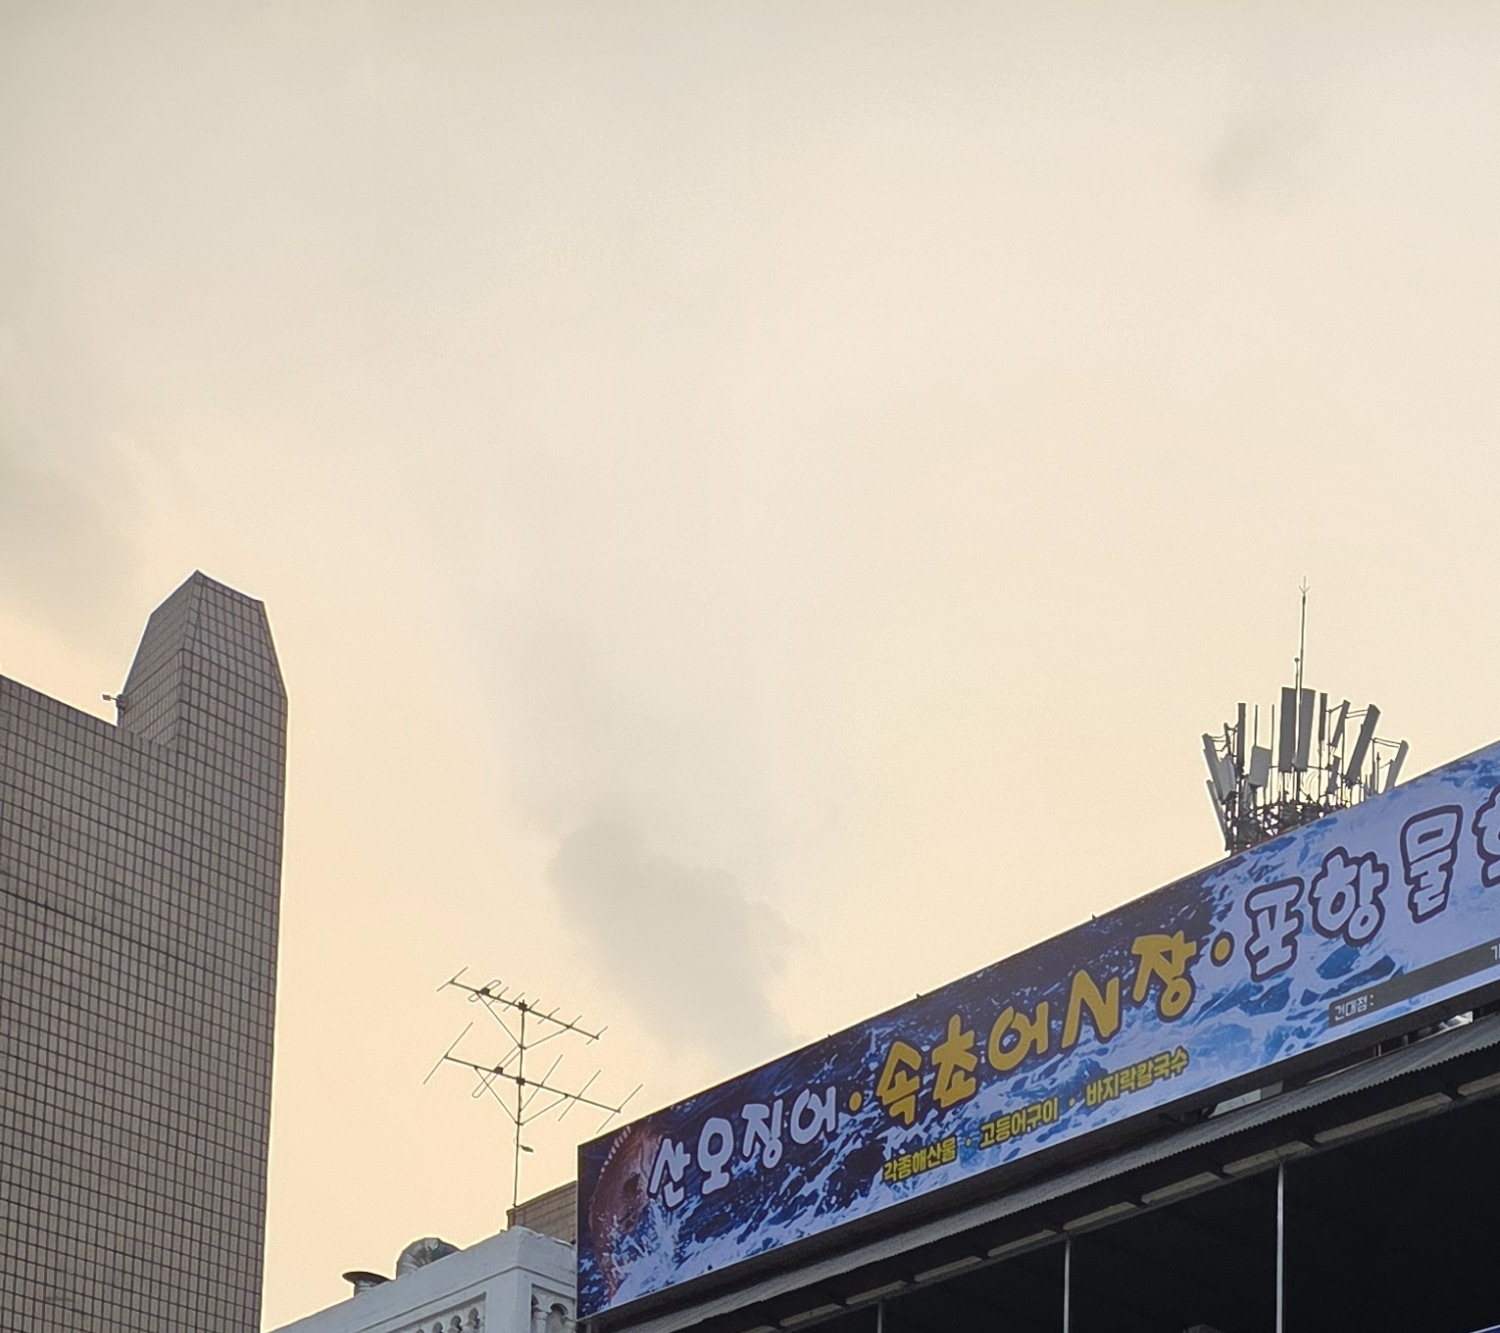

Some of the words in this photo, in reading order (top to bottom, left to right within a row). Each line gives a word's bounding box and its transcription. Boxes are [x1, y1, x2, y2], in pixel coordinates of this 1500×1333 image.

[884, 1137, 957, 1182] 각종해산물
[980, 1098, 1059, 1148] 고등어구이
[1086, 1046, 1188, 1106] 바지락칼국수
